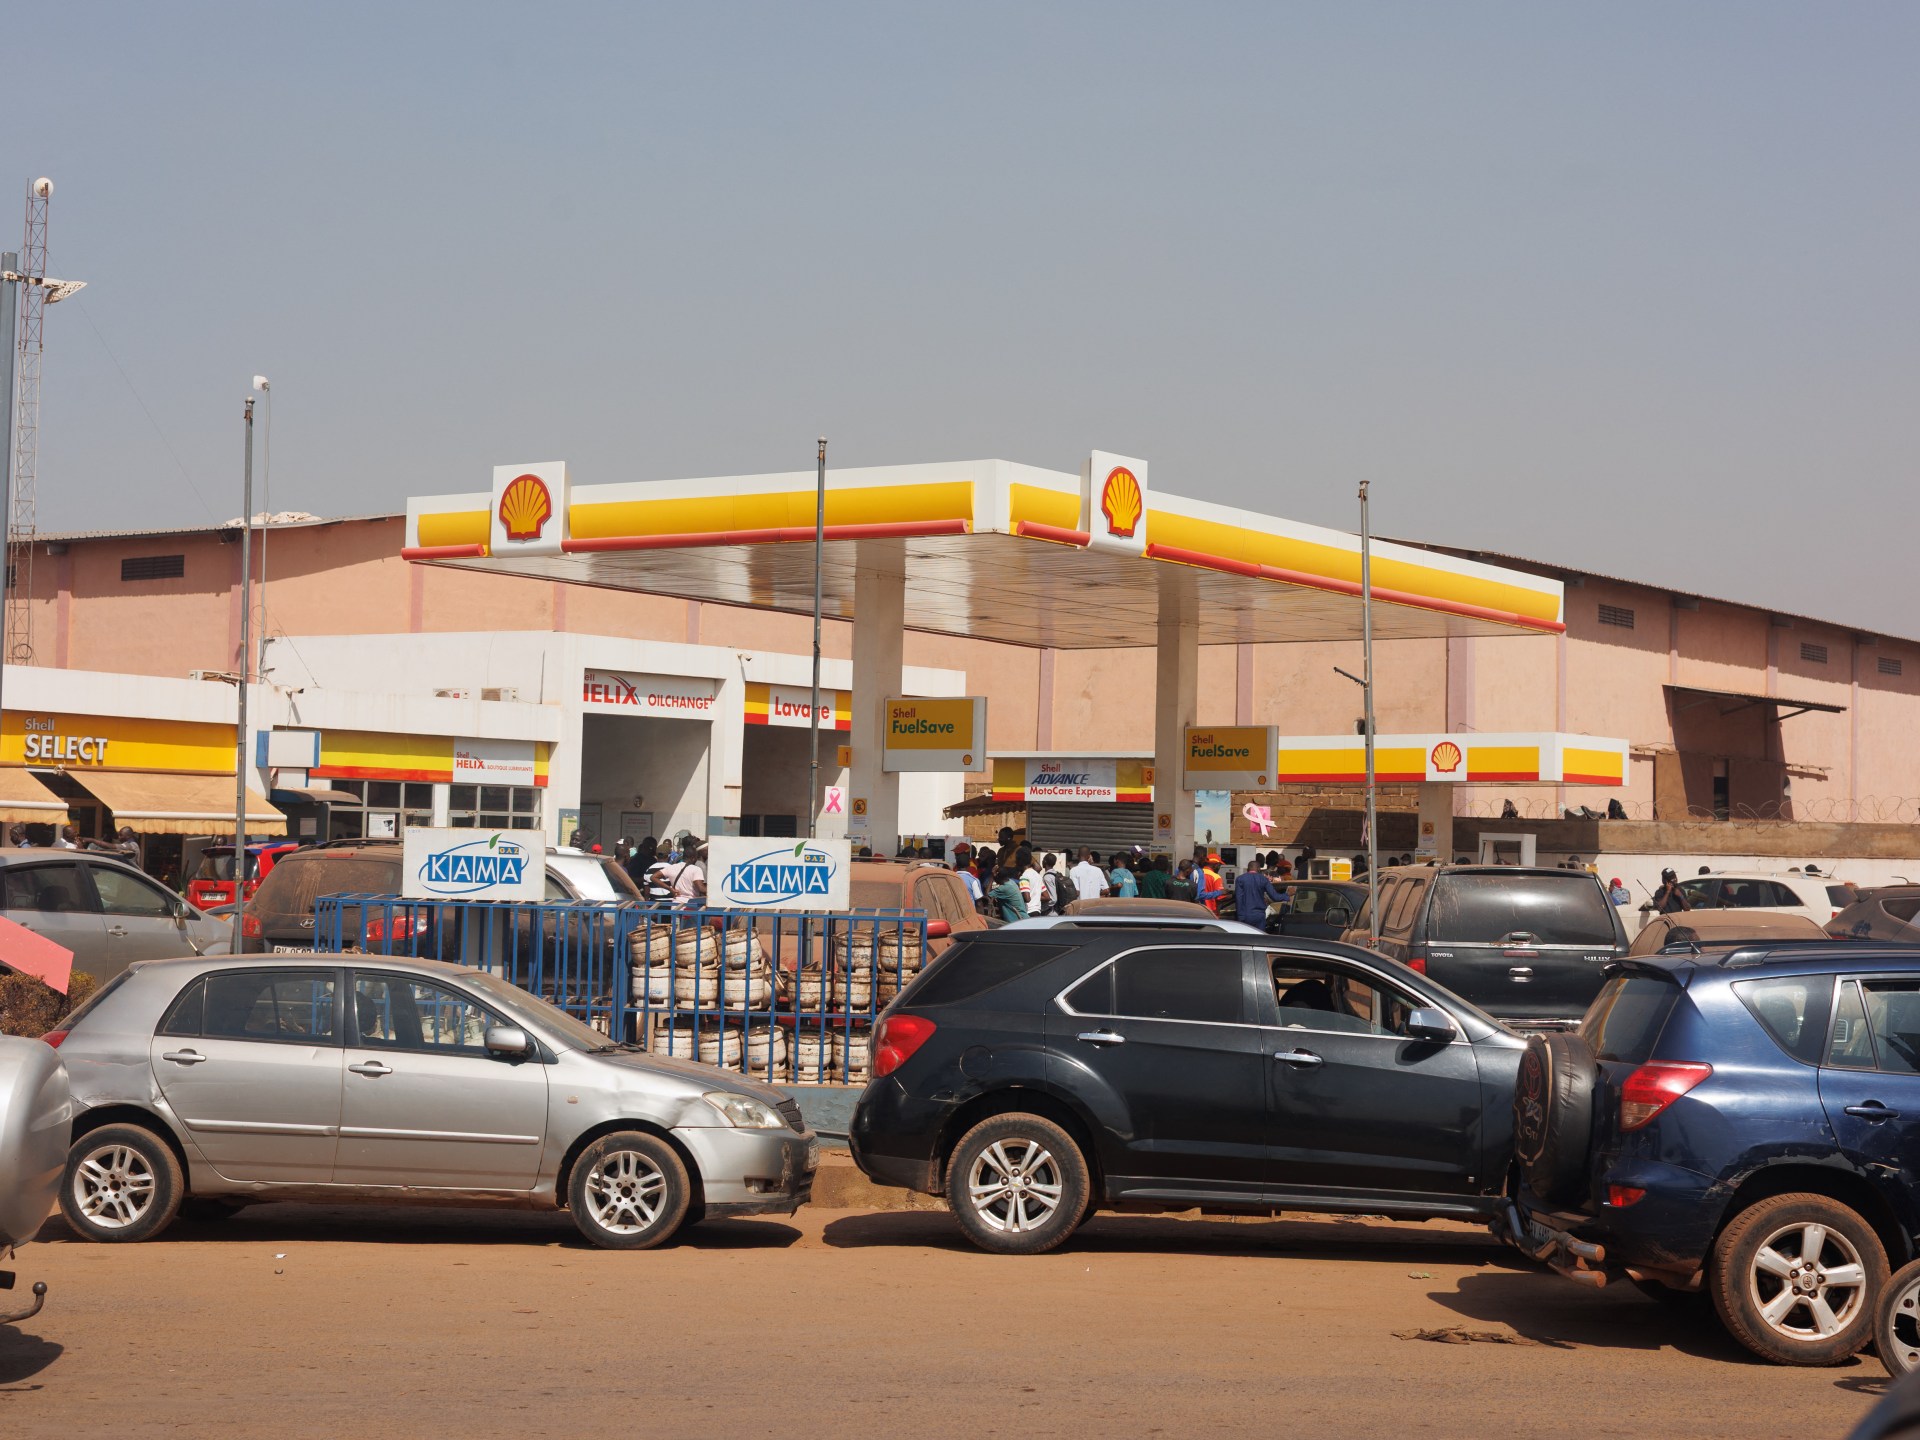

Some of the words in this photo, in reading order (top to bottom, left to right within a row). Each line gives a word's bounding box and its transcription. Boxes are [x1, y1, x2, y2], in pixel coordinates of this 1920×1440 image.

[775, 696, 830, 720] Lavae
[893, 708, 916, 718] Shell
[25, 718, 54, 731] Shell
[892, 719, 954, 734] FuelSave
[1192, 734, 1214, 744] Shell
[25, 734, 108, 761] SELECT
[1191, 744, 1249, 758] FuelSave
[456, 751, 470, 759] Shell
[456, 759, 485, 770] HELIX
[1041, 764, 1061, 772] Shell
[1031, 773, 1091, 785] ADVANCE
[1146, 770, 1153, 781] 3
[1030, 786, 1073, 795] MotoCare
[1075, 787, 1111, 798] Express
[499, 846, 519, 854] GAZ
[431, 856, 519, 882] KAMA
[734, 866, 827, 892] KAMA
